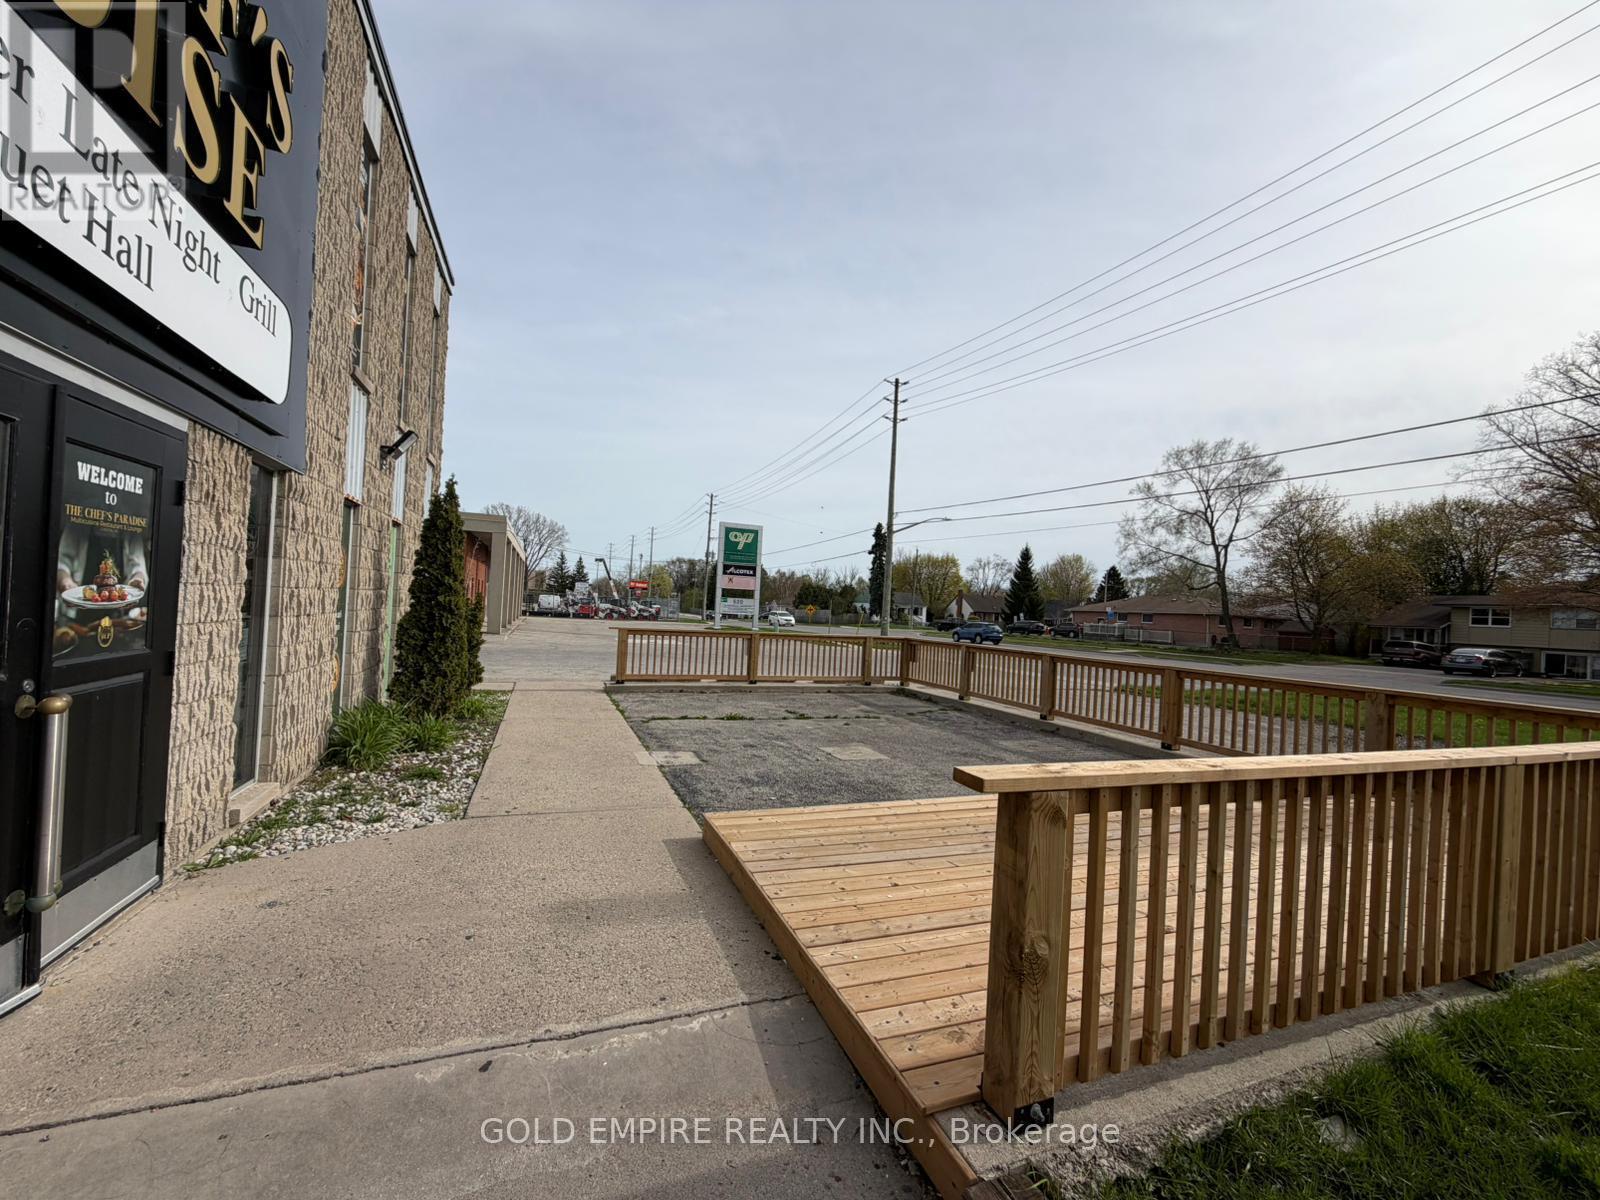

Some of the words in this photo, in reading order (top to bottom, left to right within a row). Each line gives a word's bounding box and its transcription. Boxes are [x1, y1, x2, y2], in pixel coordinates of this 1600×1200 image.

[53, 0, 264, 250] ISE
[59, 83, 139, 206] Late
[149, 178, 221, 284] Night
[239, 275, 277, 337] Grill
[82, 188, 154, 291] Hall
[77, 461, 144, 494] WELCOME
[105, 491, 118, 505] to
[65, 504, 83, 517] THE
[85, 507, 113, 522] CHEF'S
[114, 512, 148, 528] PARADISE
